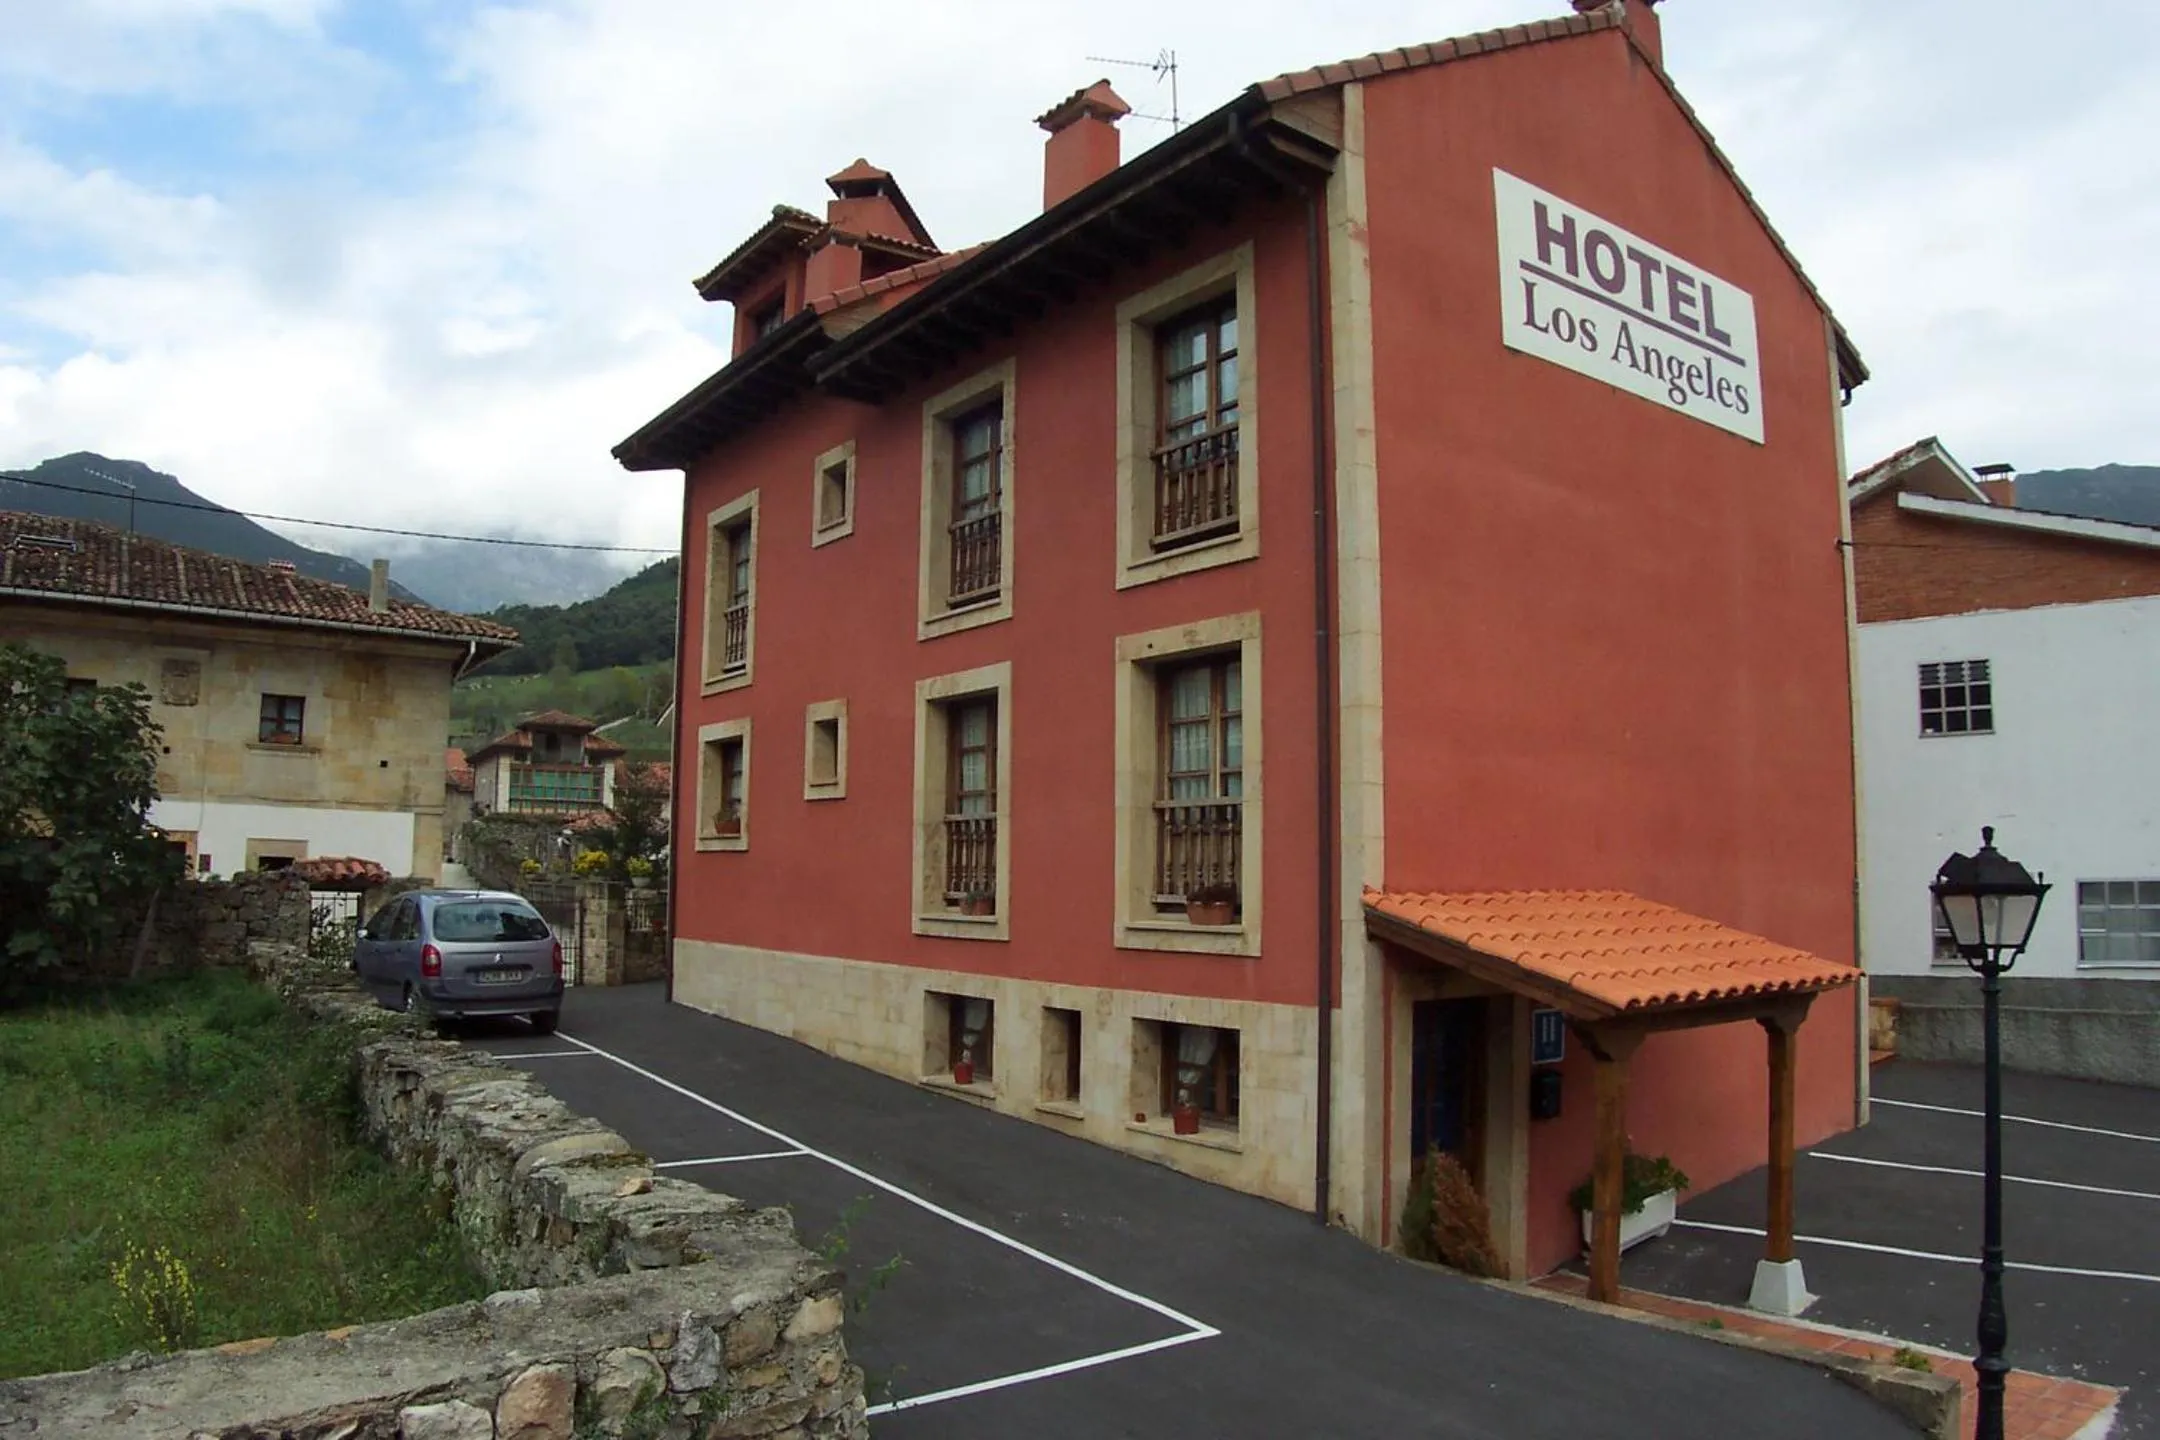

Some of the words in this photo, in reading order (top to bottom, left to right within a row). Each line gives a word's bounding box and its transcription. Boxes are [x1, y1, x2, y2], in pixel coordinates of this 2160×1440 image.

[1520, 276, 1599, 353] Los
[1610, 320, 1750, 415] Angeles
[1533, 199, 1732, 348] HOTEL
